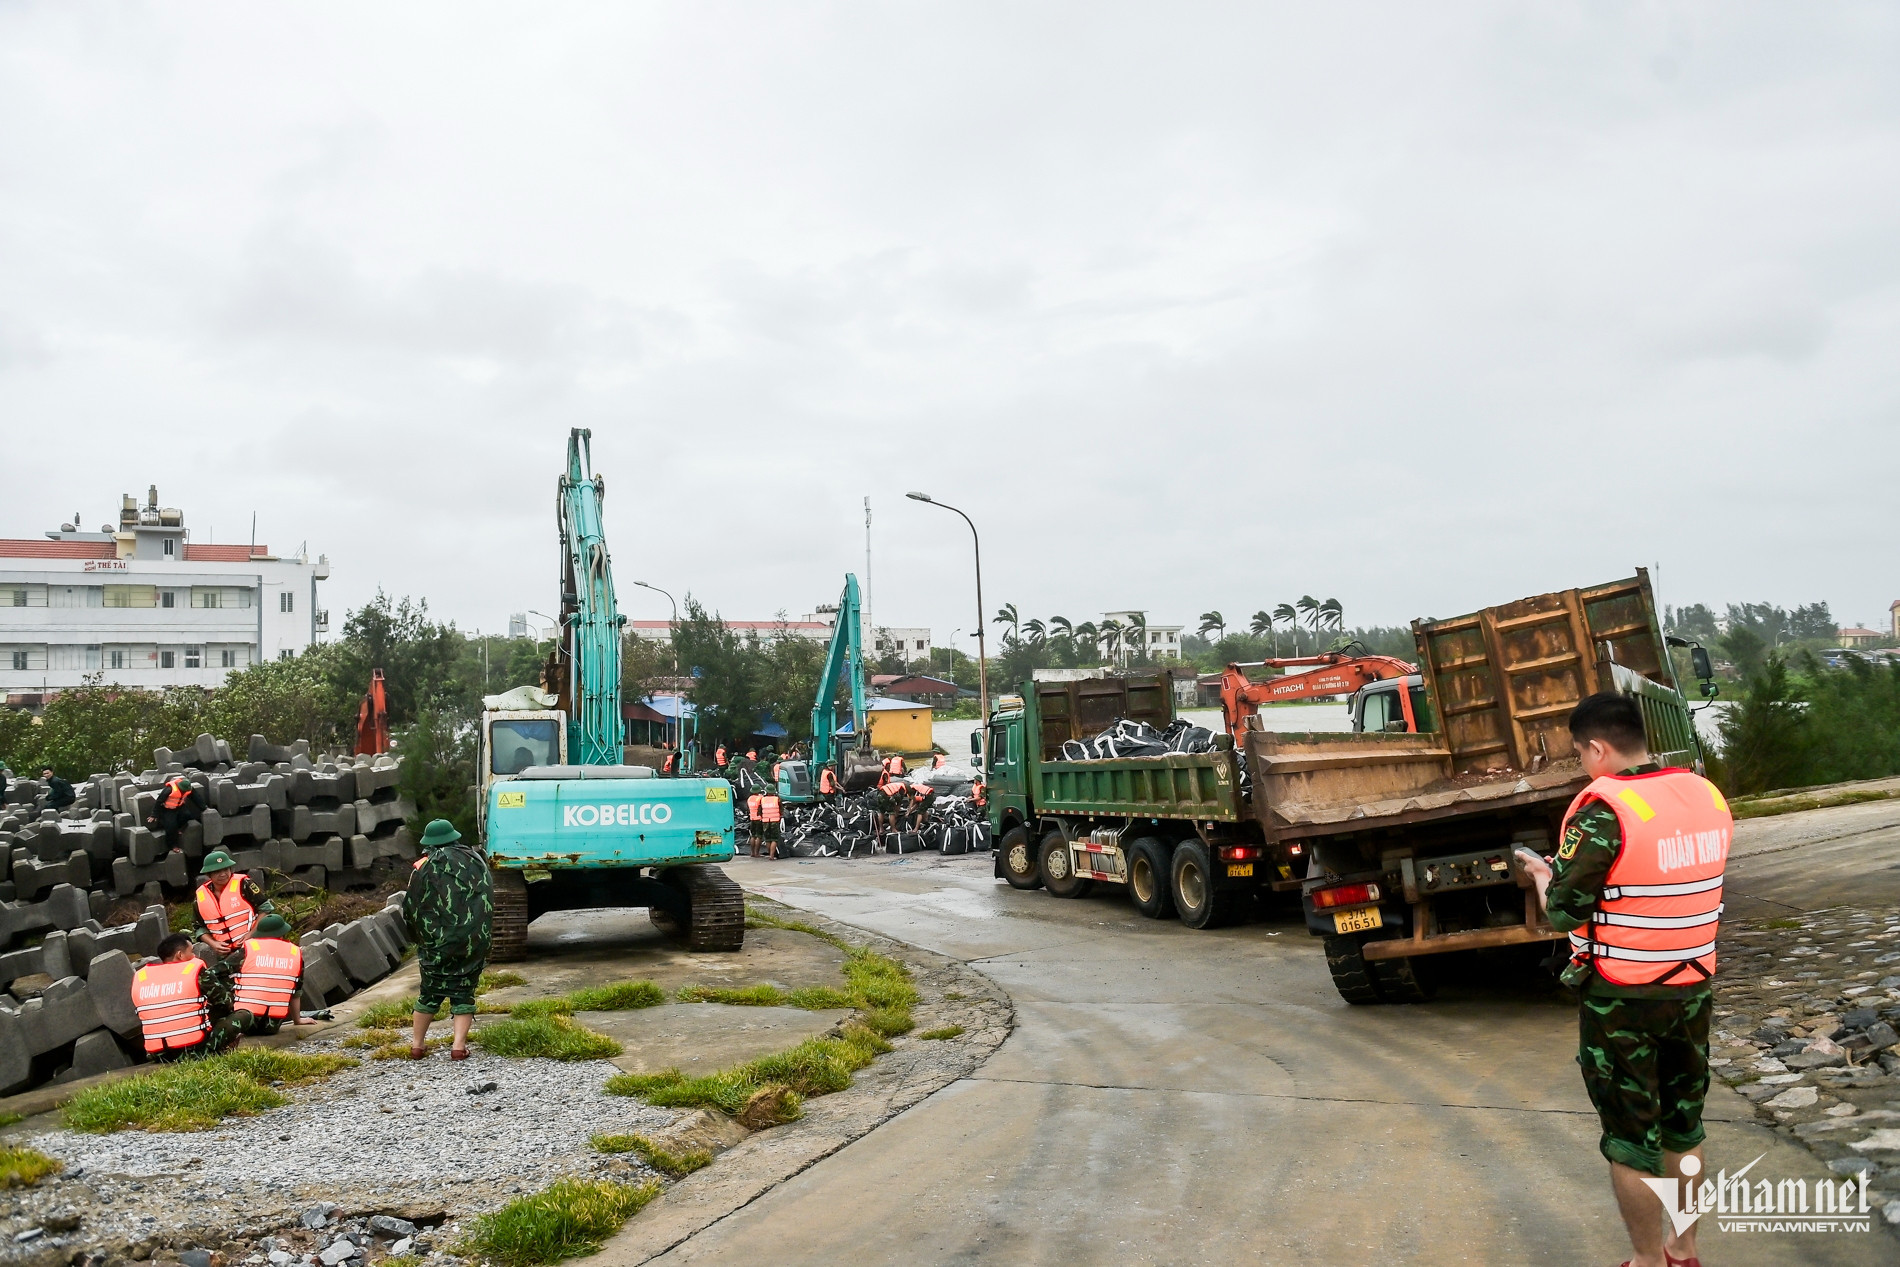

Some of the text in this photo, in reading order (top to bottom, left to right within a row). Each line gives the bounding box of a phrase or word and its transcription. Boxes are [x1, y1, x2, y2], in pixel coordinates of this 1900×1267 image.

[1273, 683, 1304, 696] HITACHI
[563, 803, 672, 827] KOBELCO
[1657, 829, 1695, 873] QUÂN
[1696, 829, 1720, 865] KHU
[1341, 917, 1376, 932] 016.51
[255, 954, 294, 970] QUÂN KHU 3
[139, 981, 183, 1000] QUÂN KHU 3
